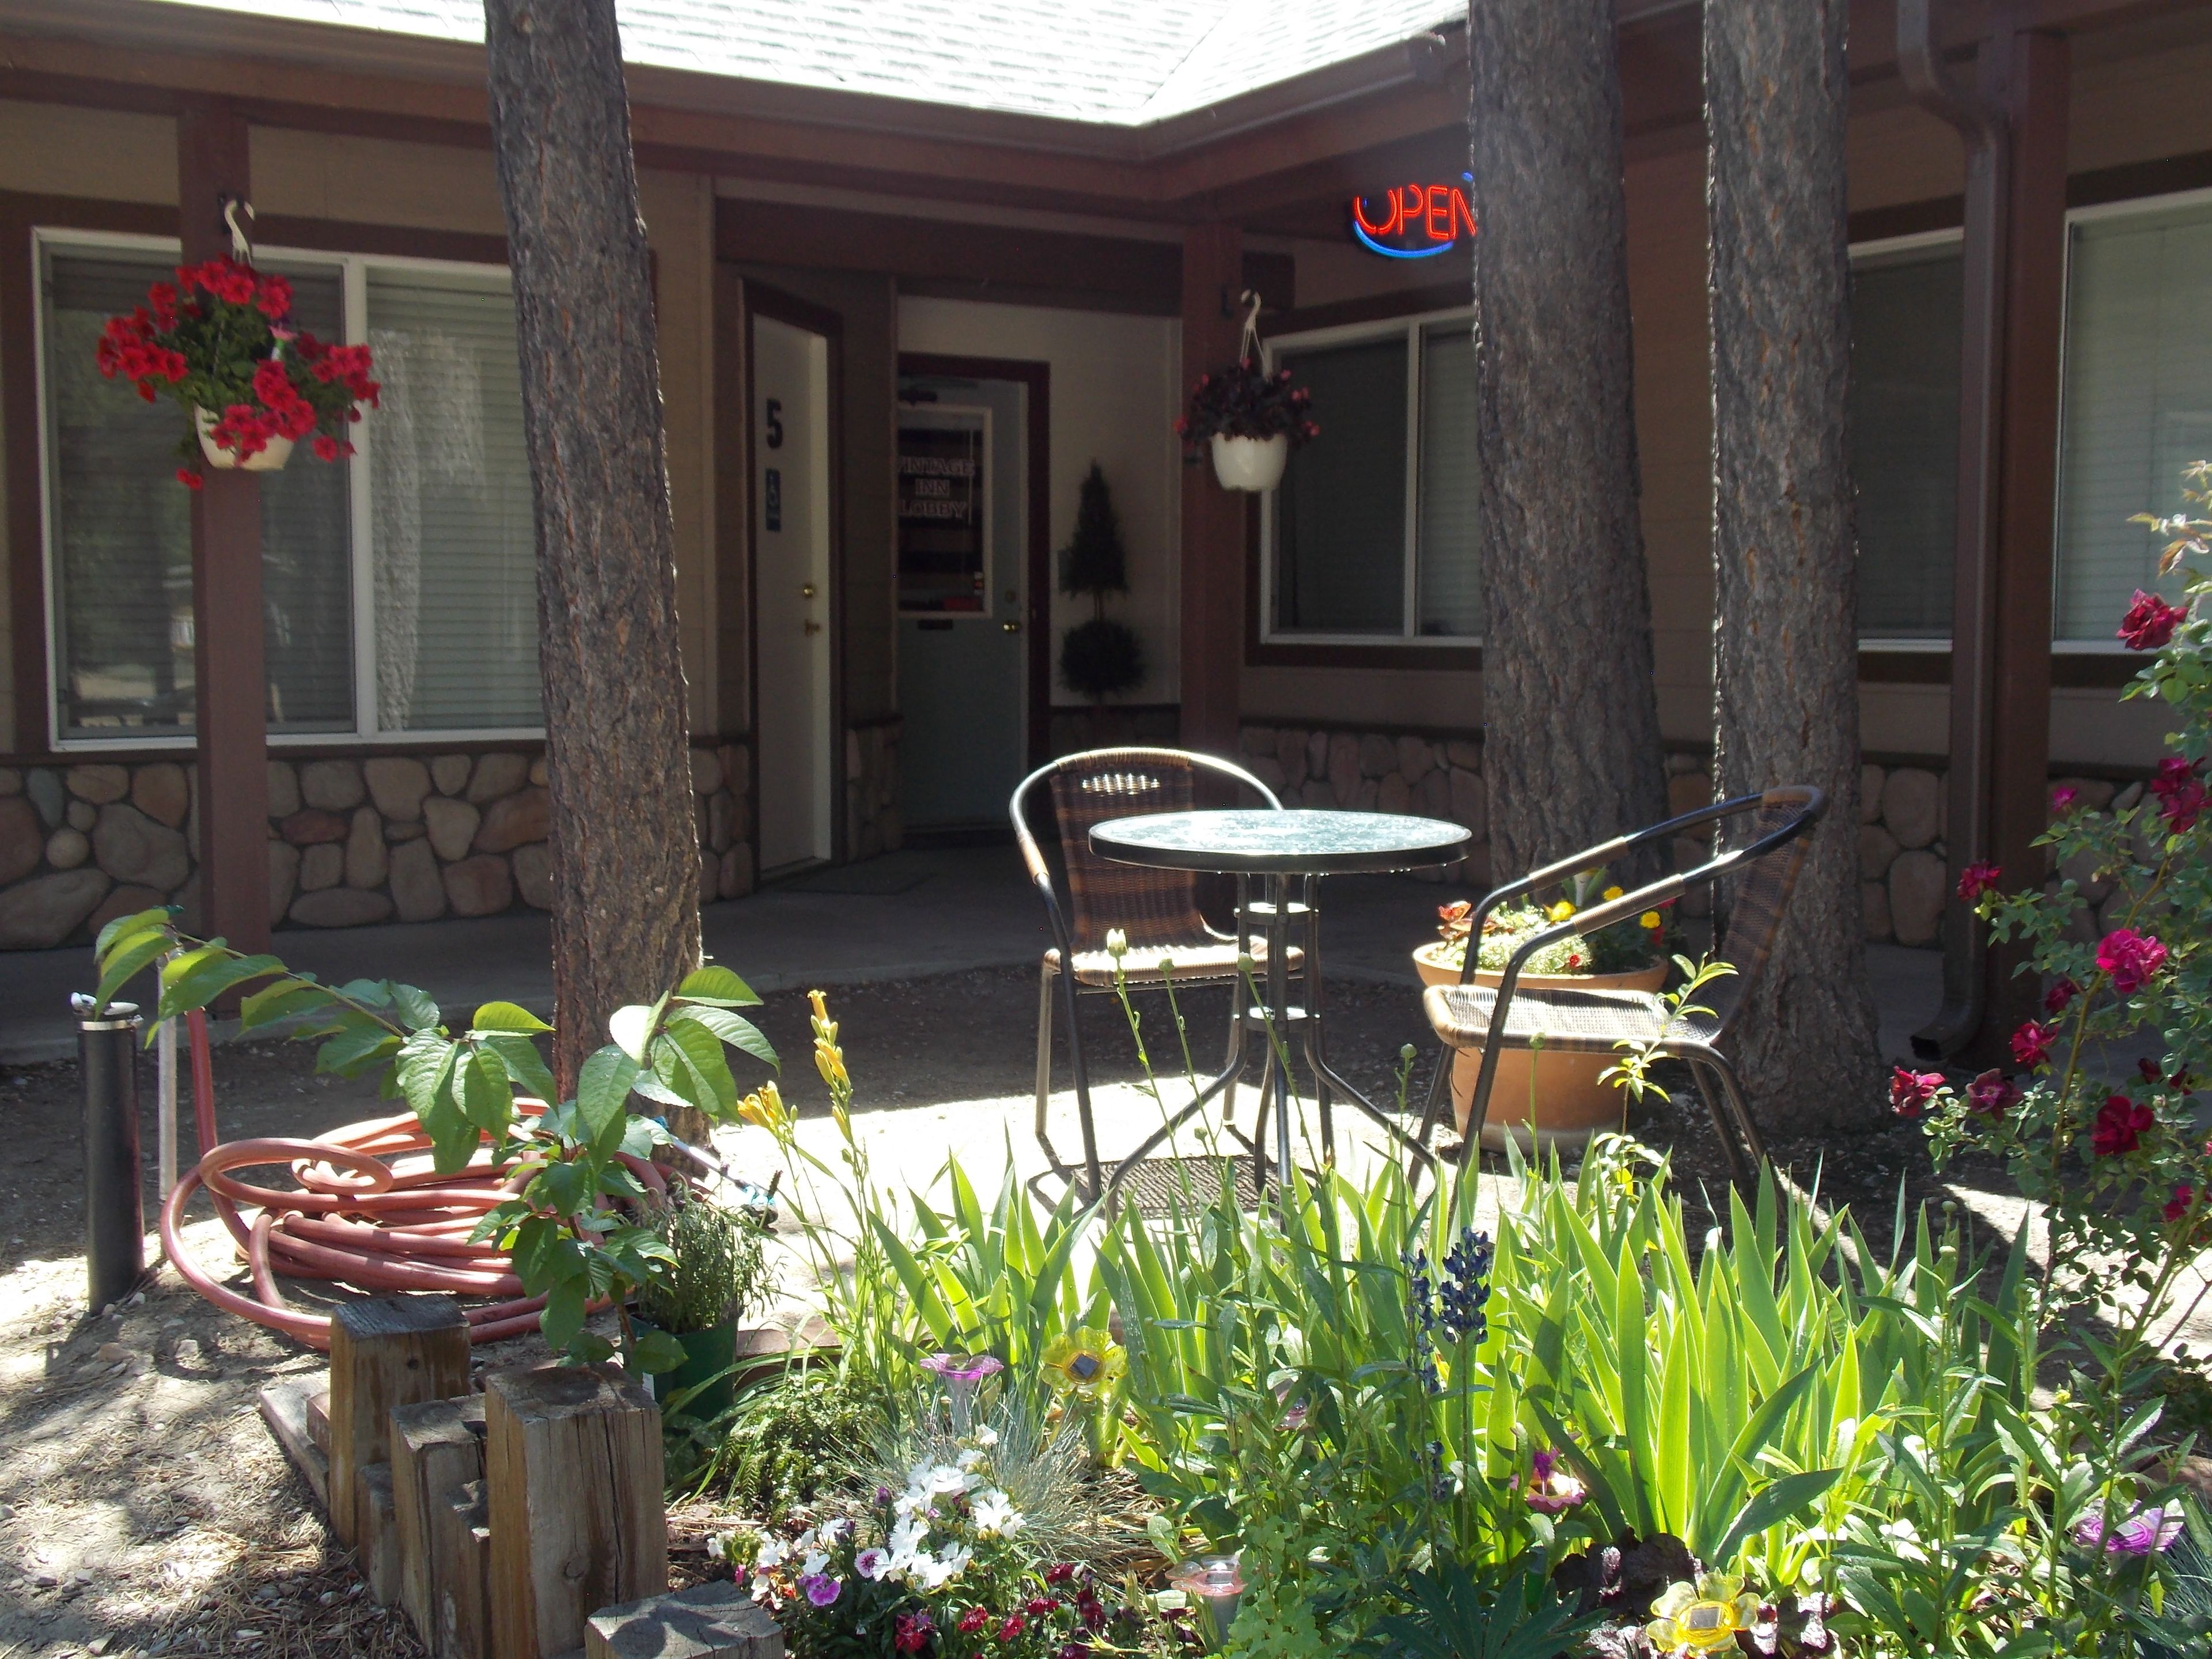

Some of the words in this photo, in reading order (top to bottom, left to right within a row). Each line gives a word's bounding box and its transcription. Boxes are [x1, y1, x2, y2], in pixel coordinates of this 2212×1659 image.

[1353, 184, 1476, 240] OPEN
[766, 398, 783, 449] 5
[915, 479, 950, 497] INN
[898, 499, 967, 518] LOBBY
